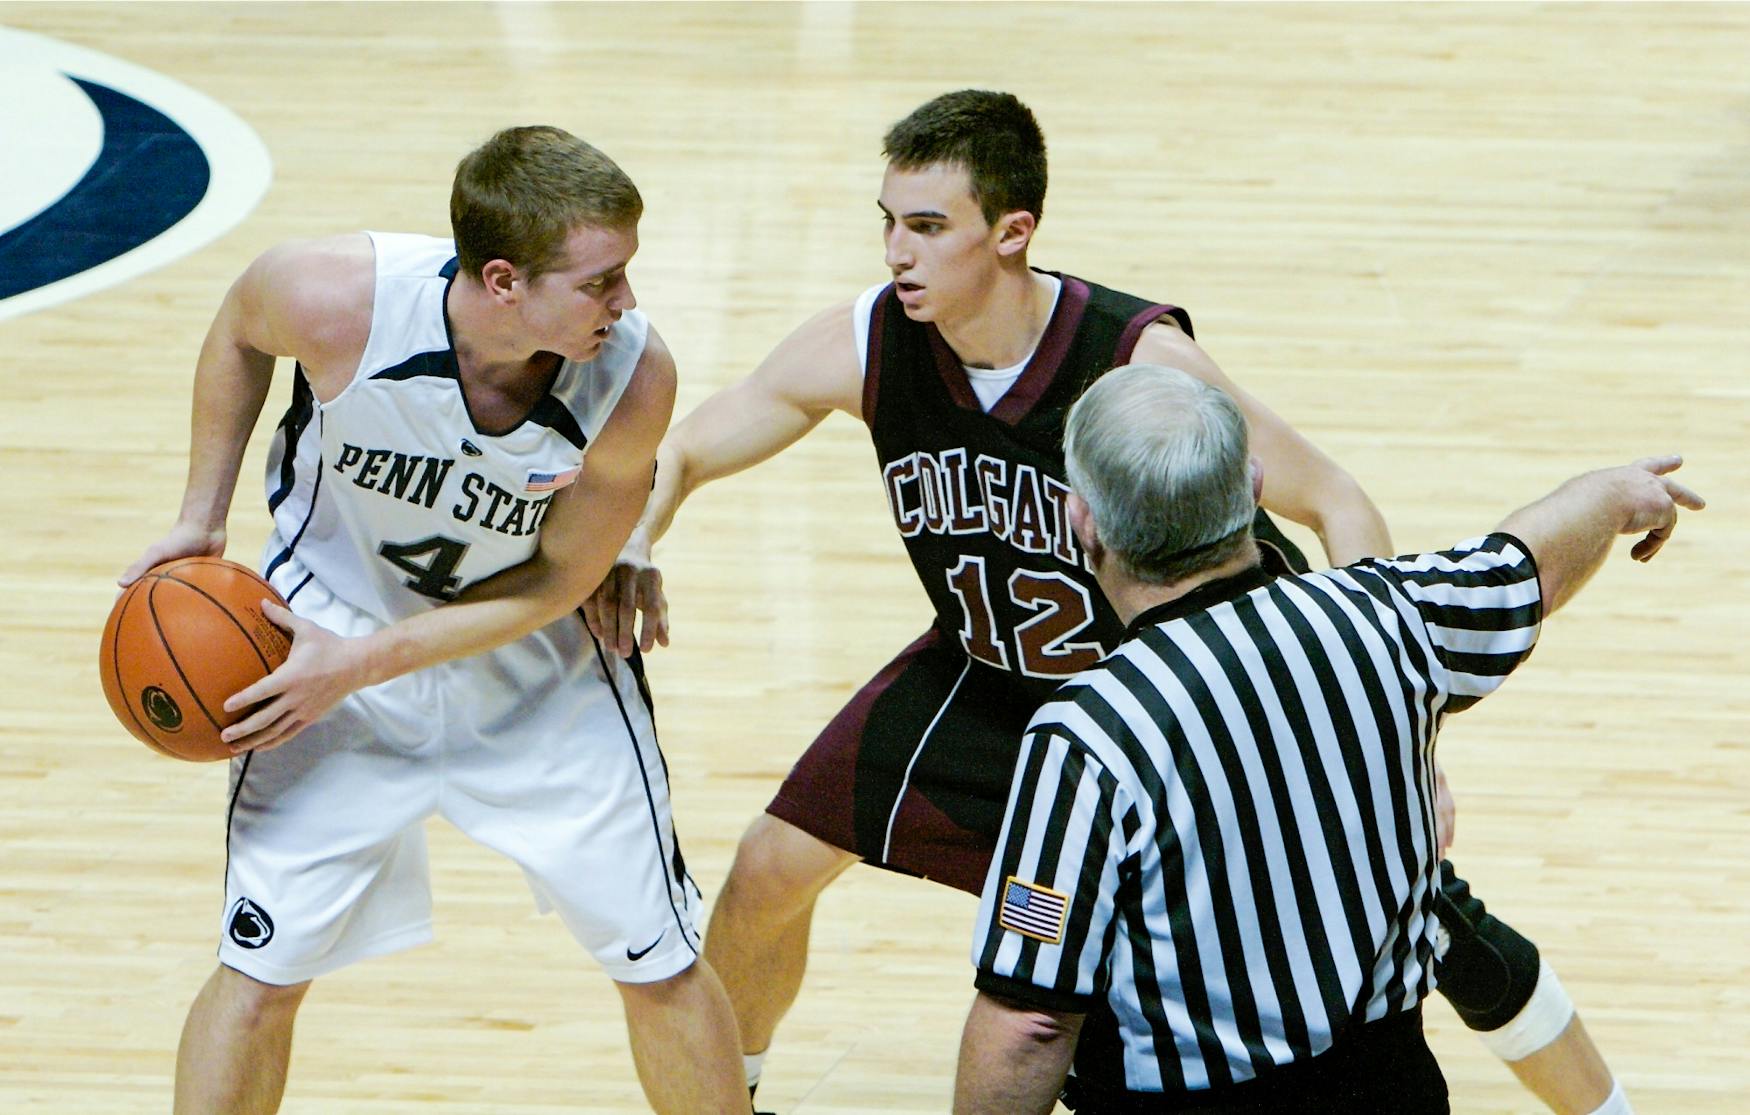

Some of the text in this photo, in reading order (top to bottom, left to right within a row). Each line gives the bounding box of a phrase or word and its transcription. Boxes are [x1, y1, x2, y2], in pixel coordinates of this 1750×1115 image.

[333, 443, 553, 537] PENN STAT
[883, 447, 1096, 576] COLGAT
[376, 533, 471, 602] 4
[945, 555, 1107, 679] 12
